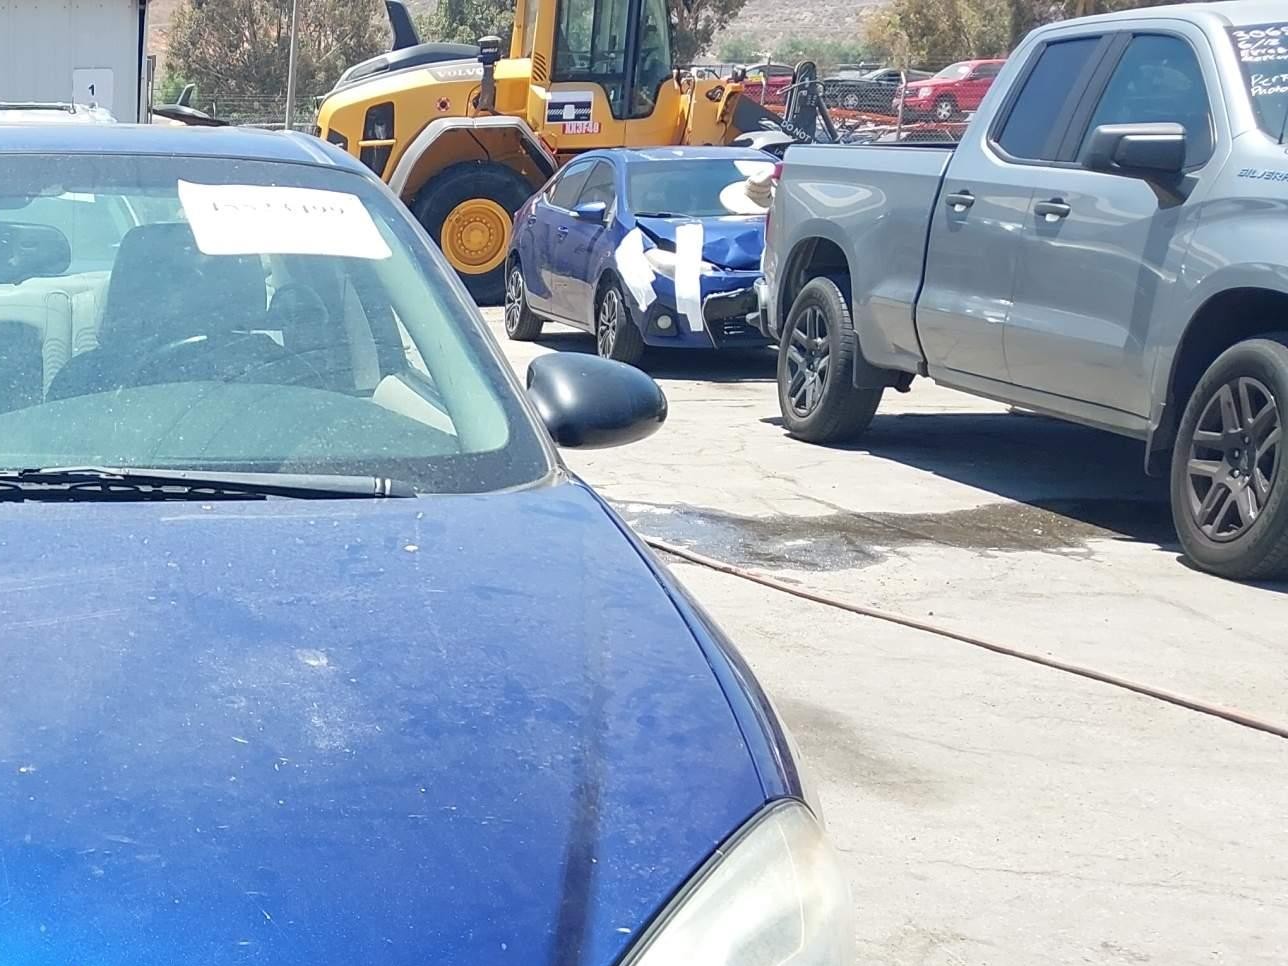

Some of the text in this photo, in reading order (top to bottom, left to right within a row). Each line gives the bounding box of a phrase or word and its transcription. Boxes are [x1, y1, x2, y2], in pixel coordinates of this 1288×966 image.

[88, 84, 95, 96] 1
[780, 120, 793, 131] DO
[793, 127, 811, 142] NOT
